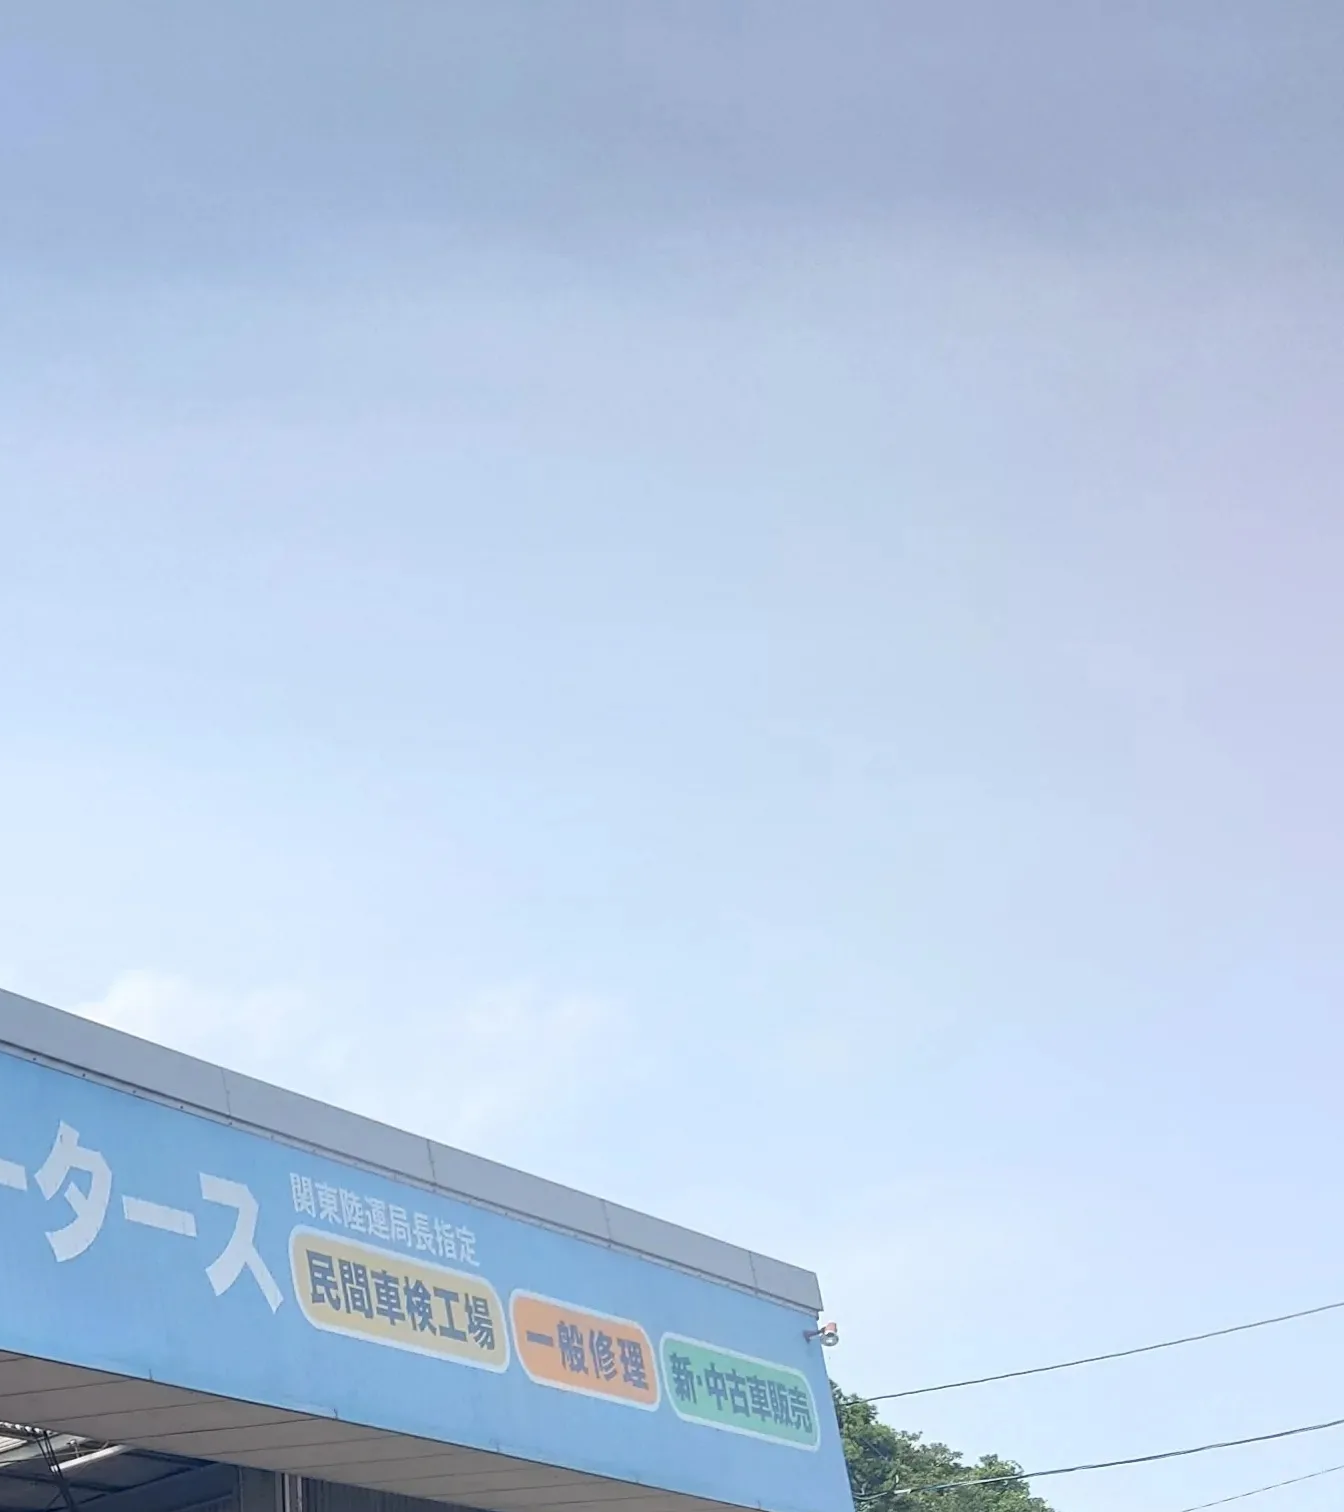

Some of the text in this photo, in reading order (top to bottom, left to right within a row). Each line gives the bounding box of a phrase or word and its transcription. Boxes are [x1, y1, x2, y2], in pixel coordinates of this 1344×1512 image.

[289, 1172, 481, 1267] 関東陸運局長指定
[305, 1248, 495, 1351] 民間車検工場
[525, 1320, 650, 1391] 一般修理
